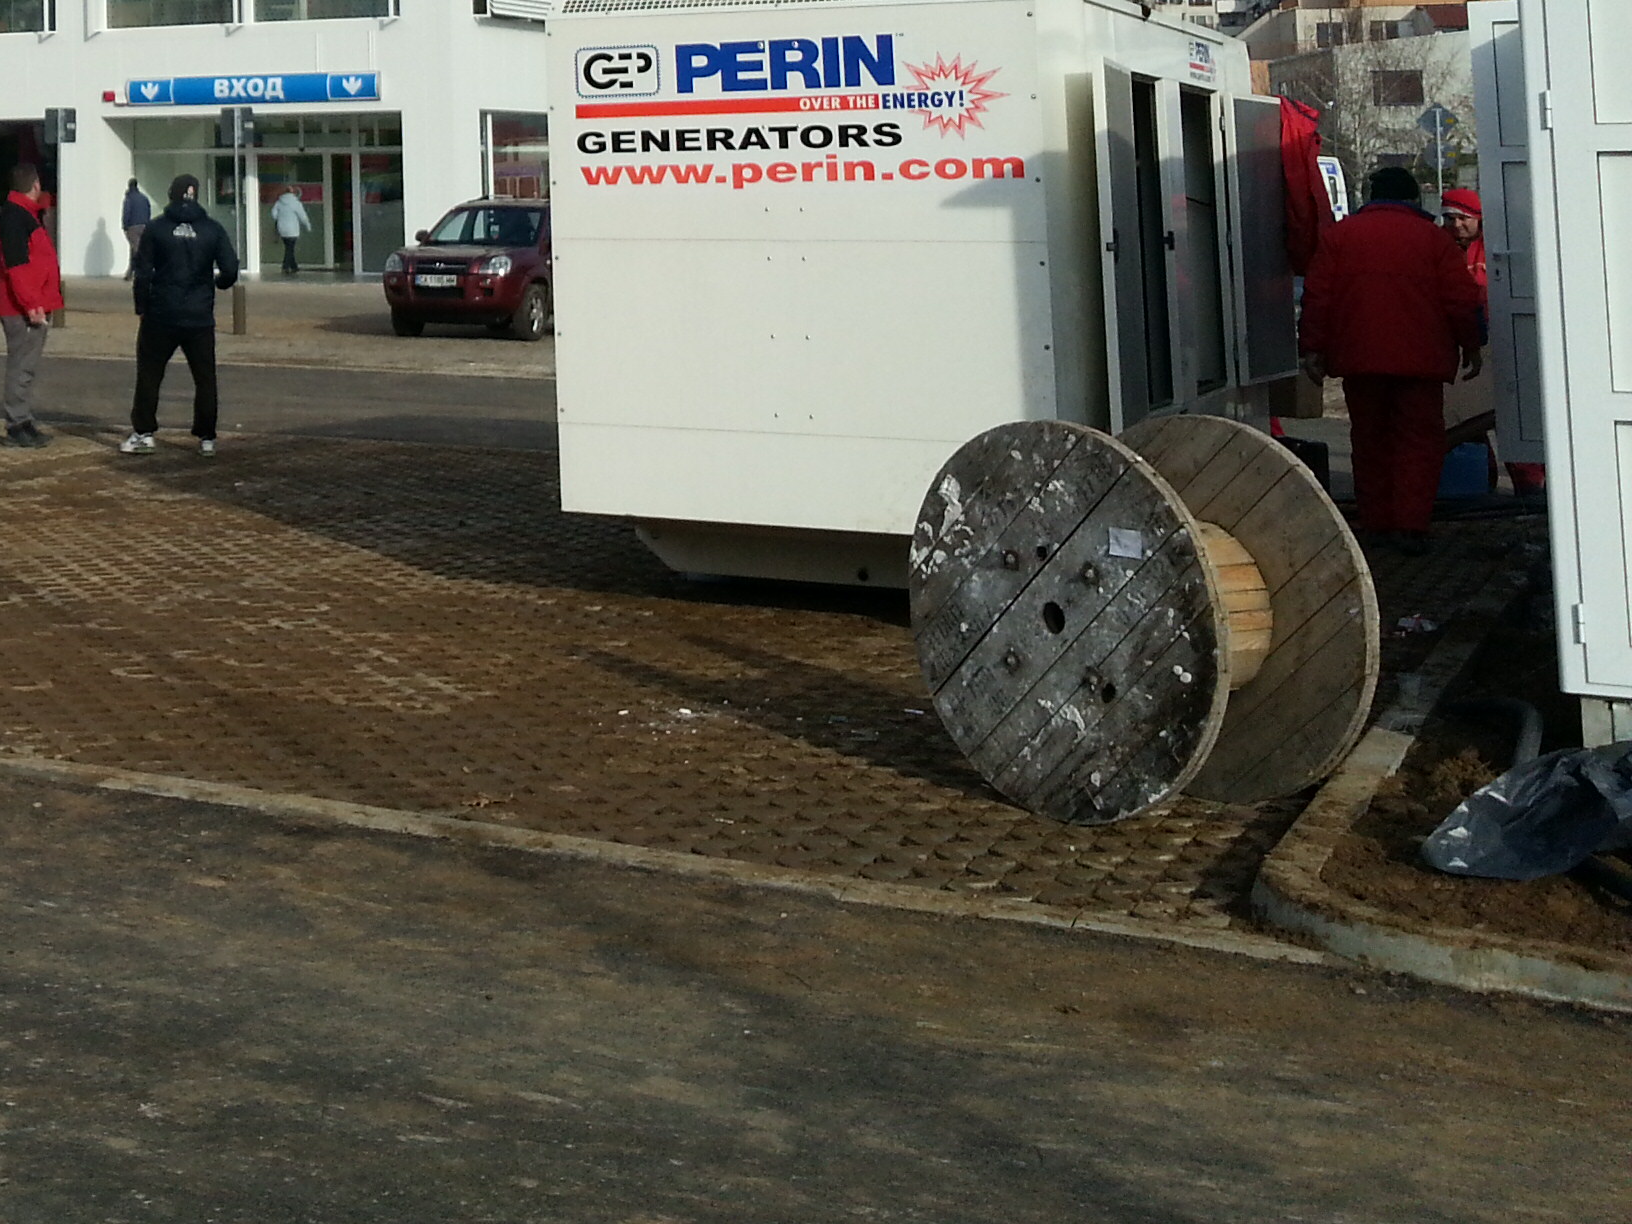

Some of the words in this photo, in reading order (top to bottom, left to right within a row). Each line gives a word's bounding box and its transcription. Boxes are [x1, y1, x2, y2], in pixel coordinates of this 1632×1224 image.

[675, 34, 896, 94] PERIN
[213, 76, 285, 100] ВХОД
[799, 97, 841, 111] OVER
[847, 94, 875, 109] THE
[881, 90, 965, 110] ENERGY!
[576, 122, 903, 154] GENERATORS
[579, 154, 1026, 190] www.perin.com
